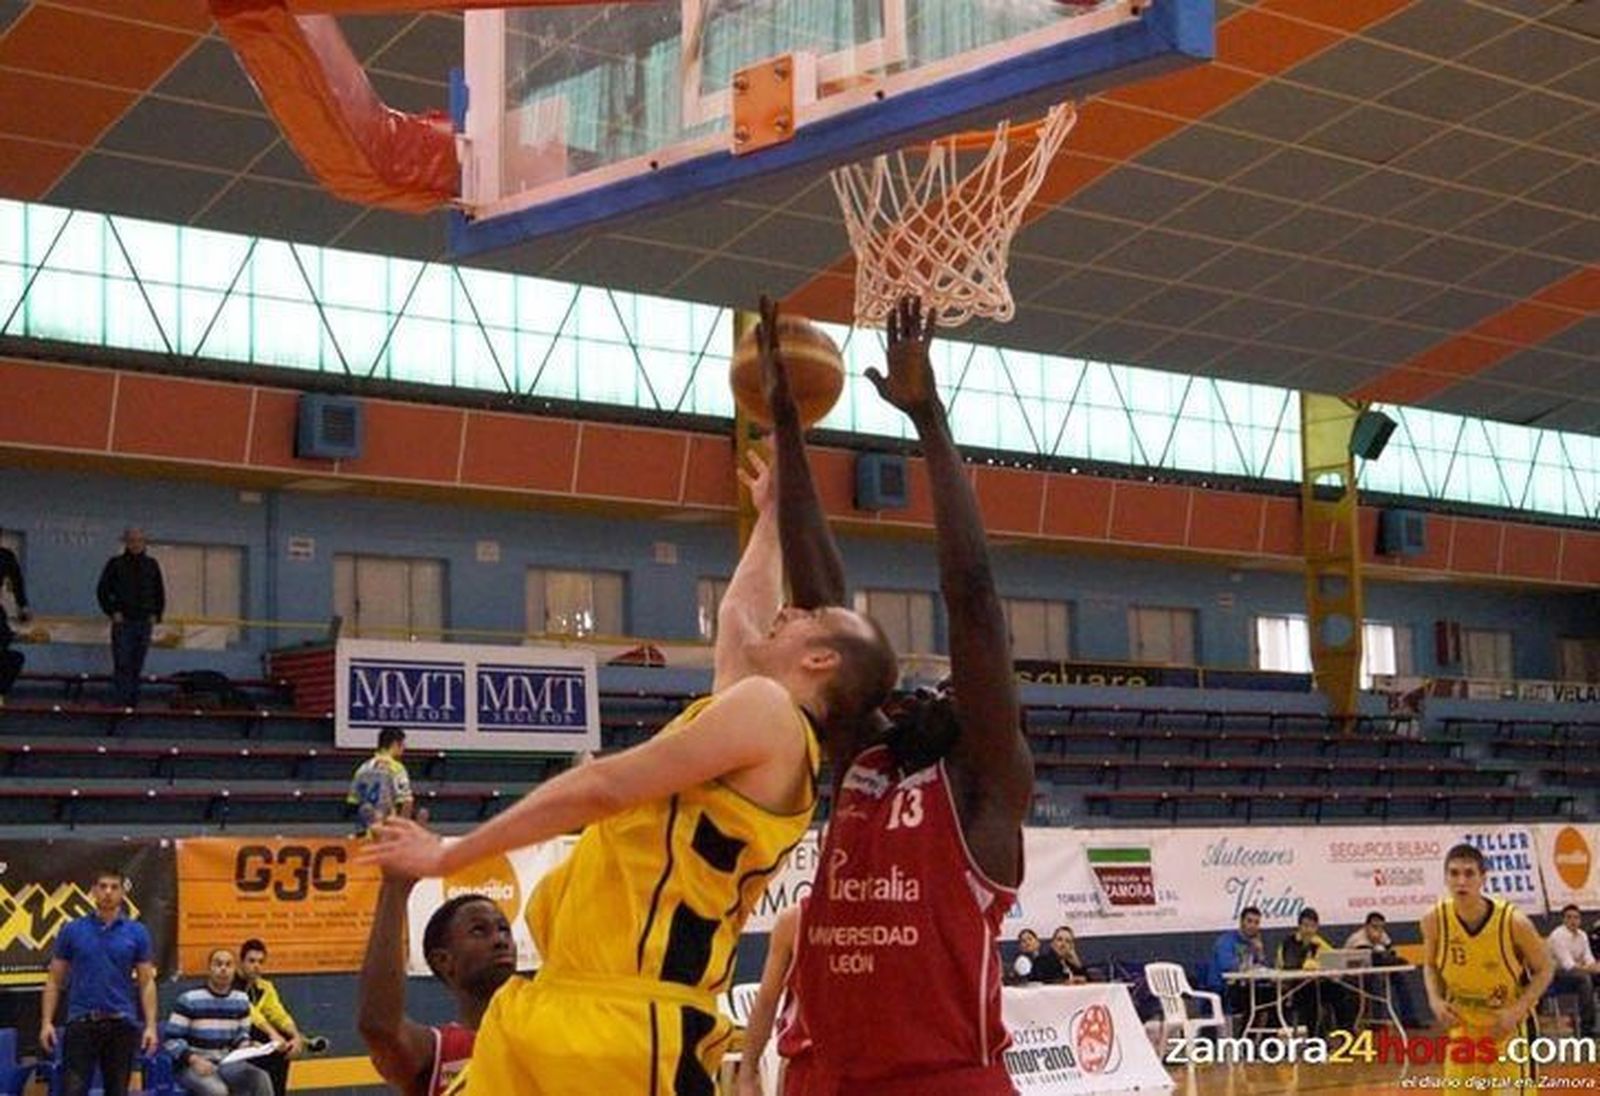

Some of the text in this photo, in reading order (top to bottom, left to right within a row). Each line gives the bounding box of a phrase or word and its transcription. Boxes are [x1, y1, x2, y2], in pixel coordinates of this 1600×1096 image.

[352, 669, 463, 710] MMT
[480, 674, 582, 714] MMT
[366, 707, 450, 721] SEGUROS
[493, 711, 572, 724] SEGUROS
[886, 788, 924, 829] 13
[1201, 838, 1295, 868] Autocares
[235, 845, 347, 901] G3C
[1105, 884, 1153, 898] ZAMORA
